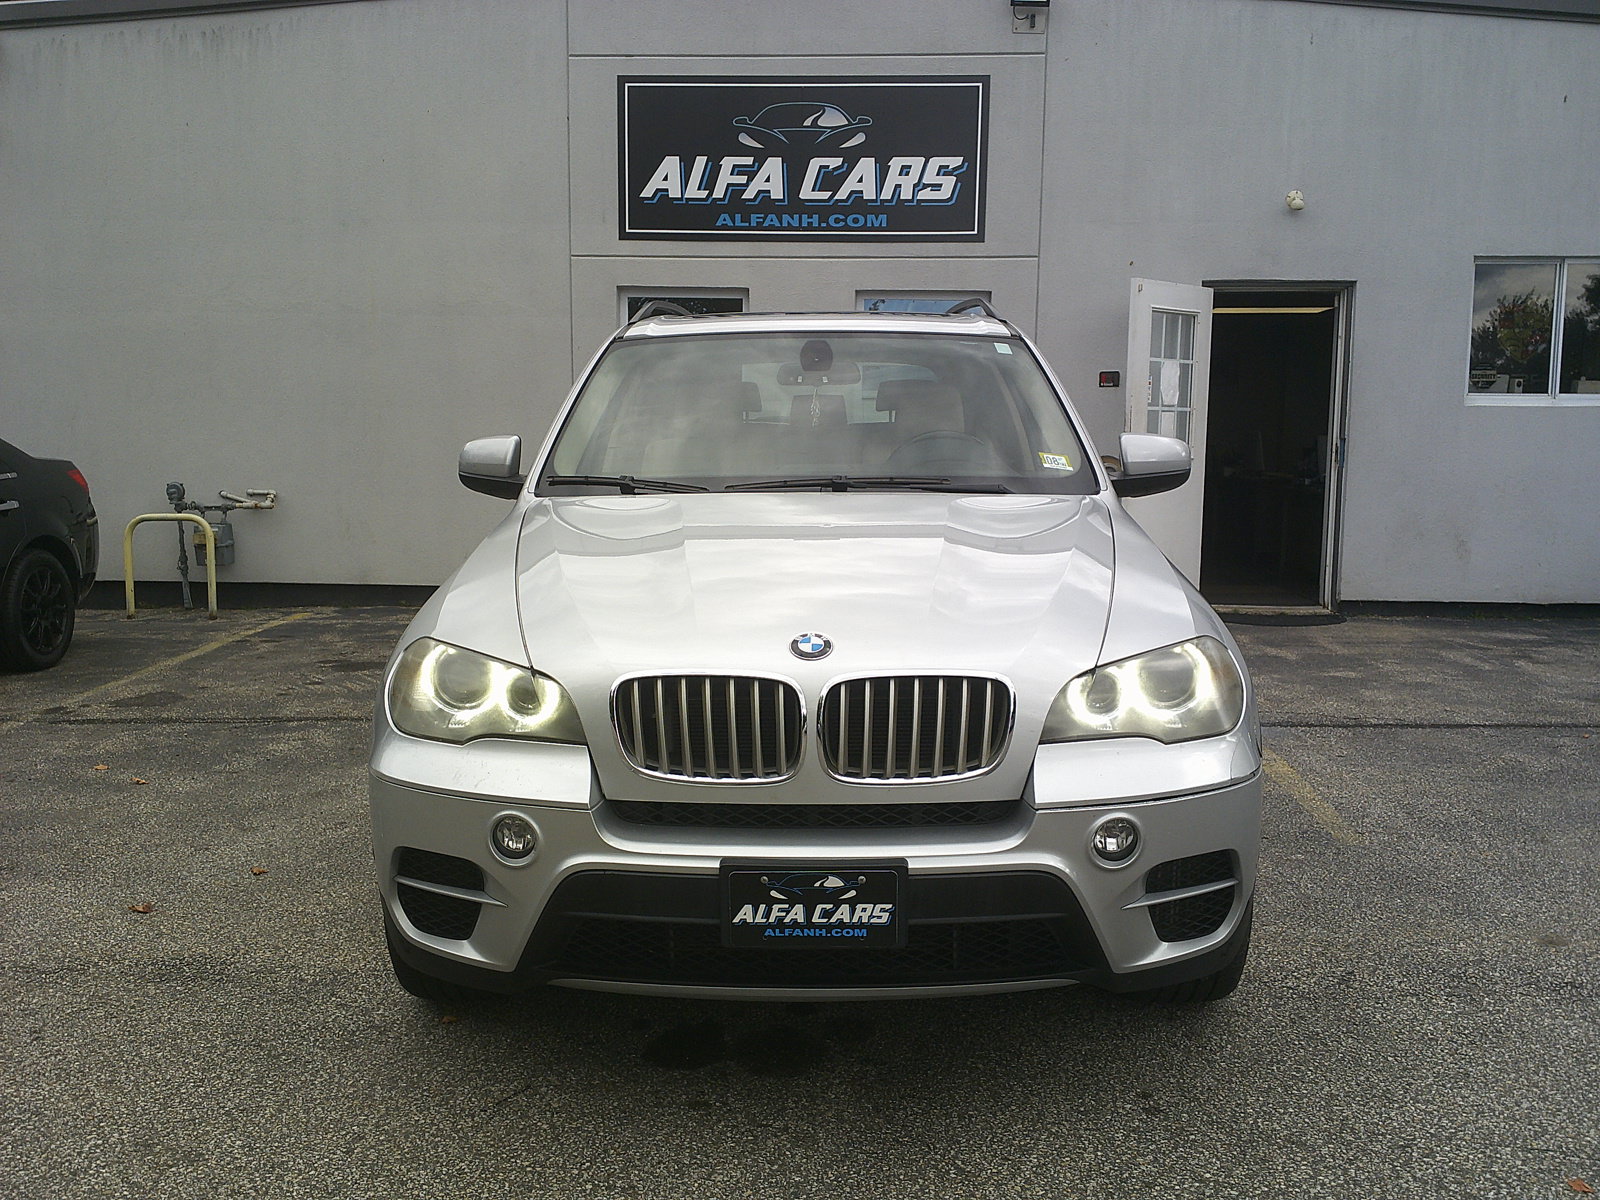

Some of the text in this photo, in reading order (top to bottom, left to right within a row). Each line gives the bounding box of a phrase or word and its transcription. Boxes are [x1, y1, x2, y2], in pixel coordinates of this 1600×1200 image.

[639, 155, 968, 206] ALFA CARS
[714, 213, 888, 228] ALFANH.COM
[732, 903, 895, 926] ALFA CARS
[764, 928, 868, 937] ALFANH.COM
